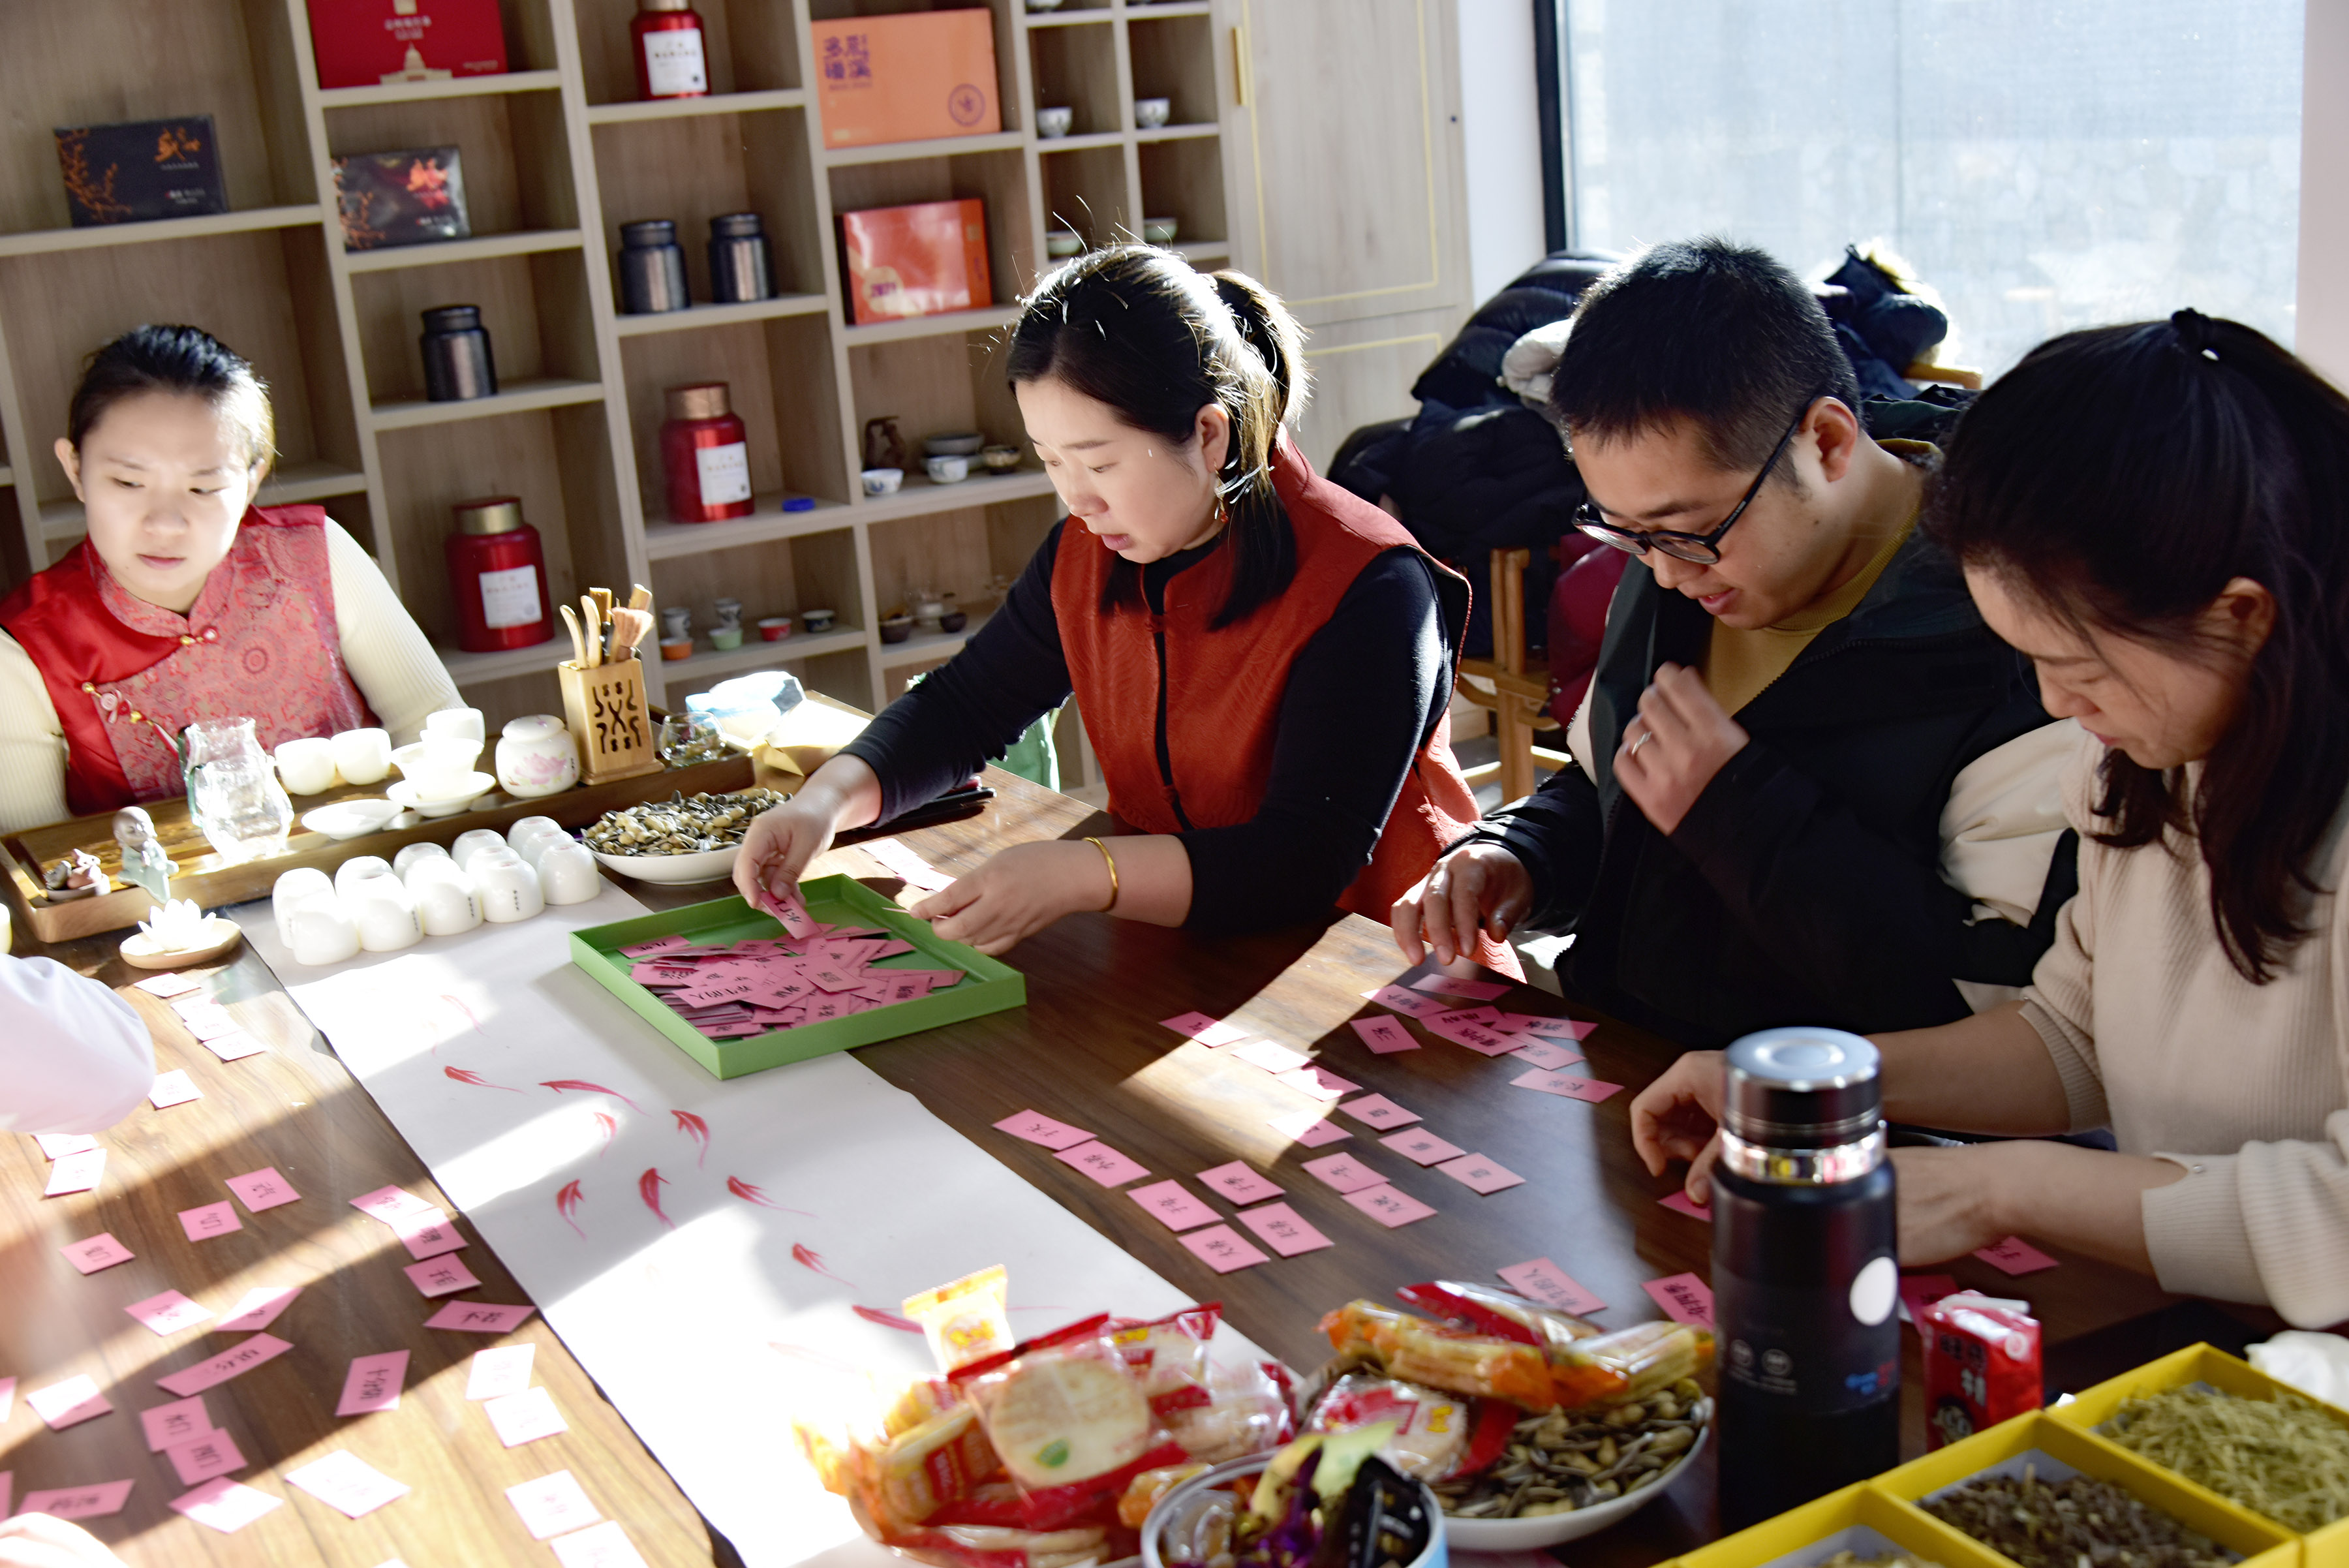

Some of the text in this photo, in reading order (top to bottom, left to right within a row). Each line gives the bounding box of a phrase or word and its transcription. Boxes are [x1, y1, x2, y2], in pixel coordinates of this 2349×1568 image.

[696, 985, 752, 1000] 养生的人
[251, 1182, 277, 1199] 元气
